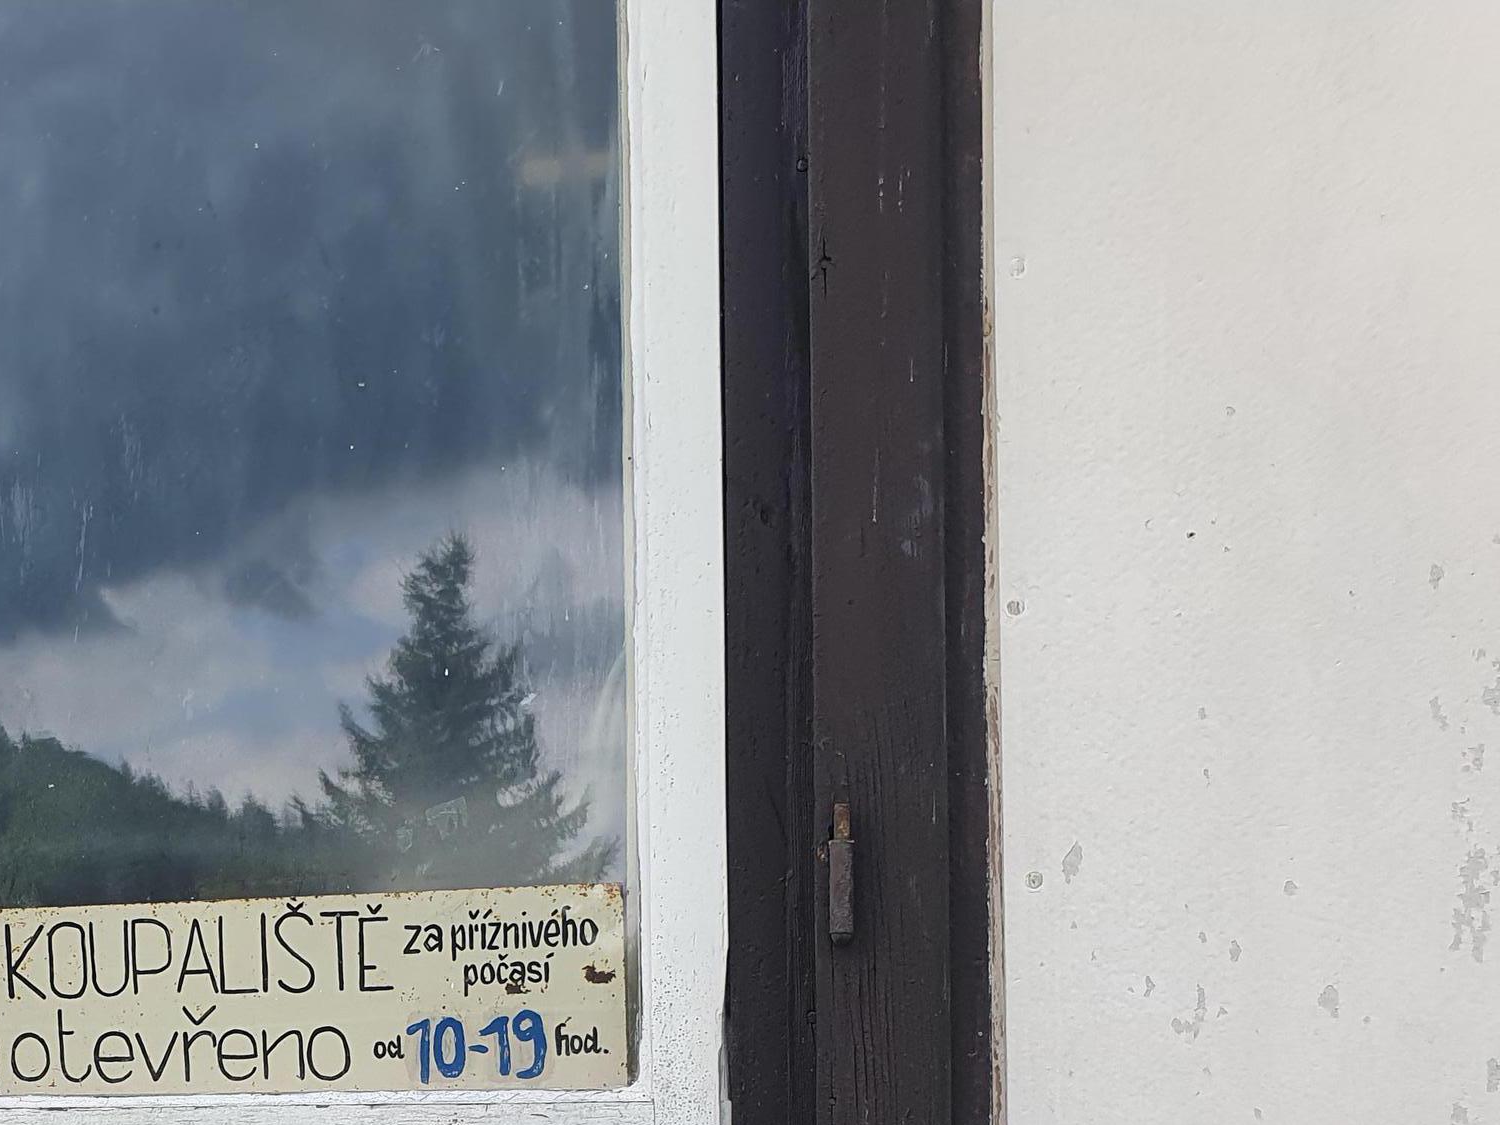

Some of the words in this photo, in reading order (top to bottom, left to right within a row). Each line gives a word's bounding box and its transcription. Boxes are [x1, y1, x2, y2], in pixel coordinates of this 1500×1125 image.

[4, 902, 395, 1001] KOUPALIŠTĚ
[403, 923, 445, 956] za
[450, 906, 600, 958] příznivého
[463, 953, 555, 997] počasí
[10, 1005, 353, 1084] otevřeno
[373, 1033, 405, 1061] od
[405, 1008, 549, 1086] 10-19
[554, 1016, 611, 1058] hod.
